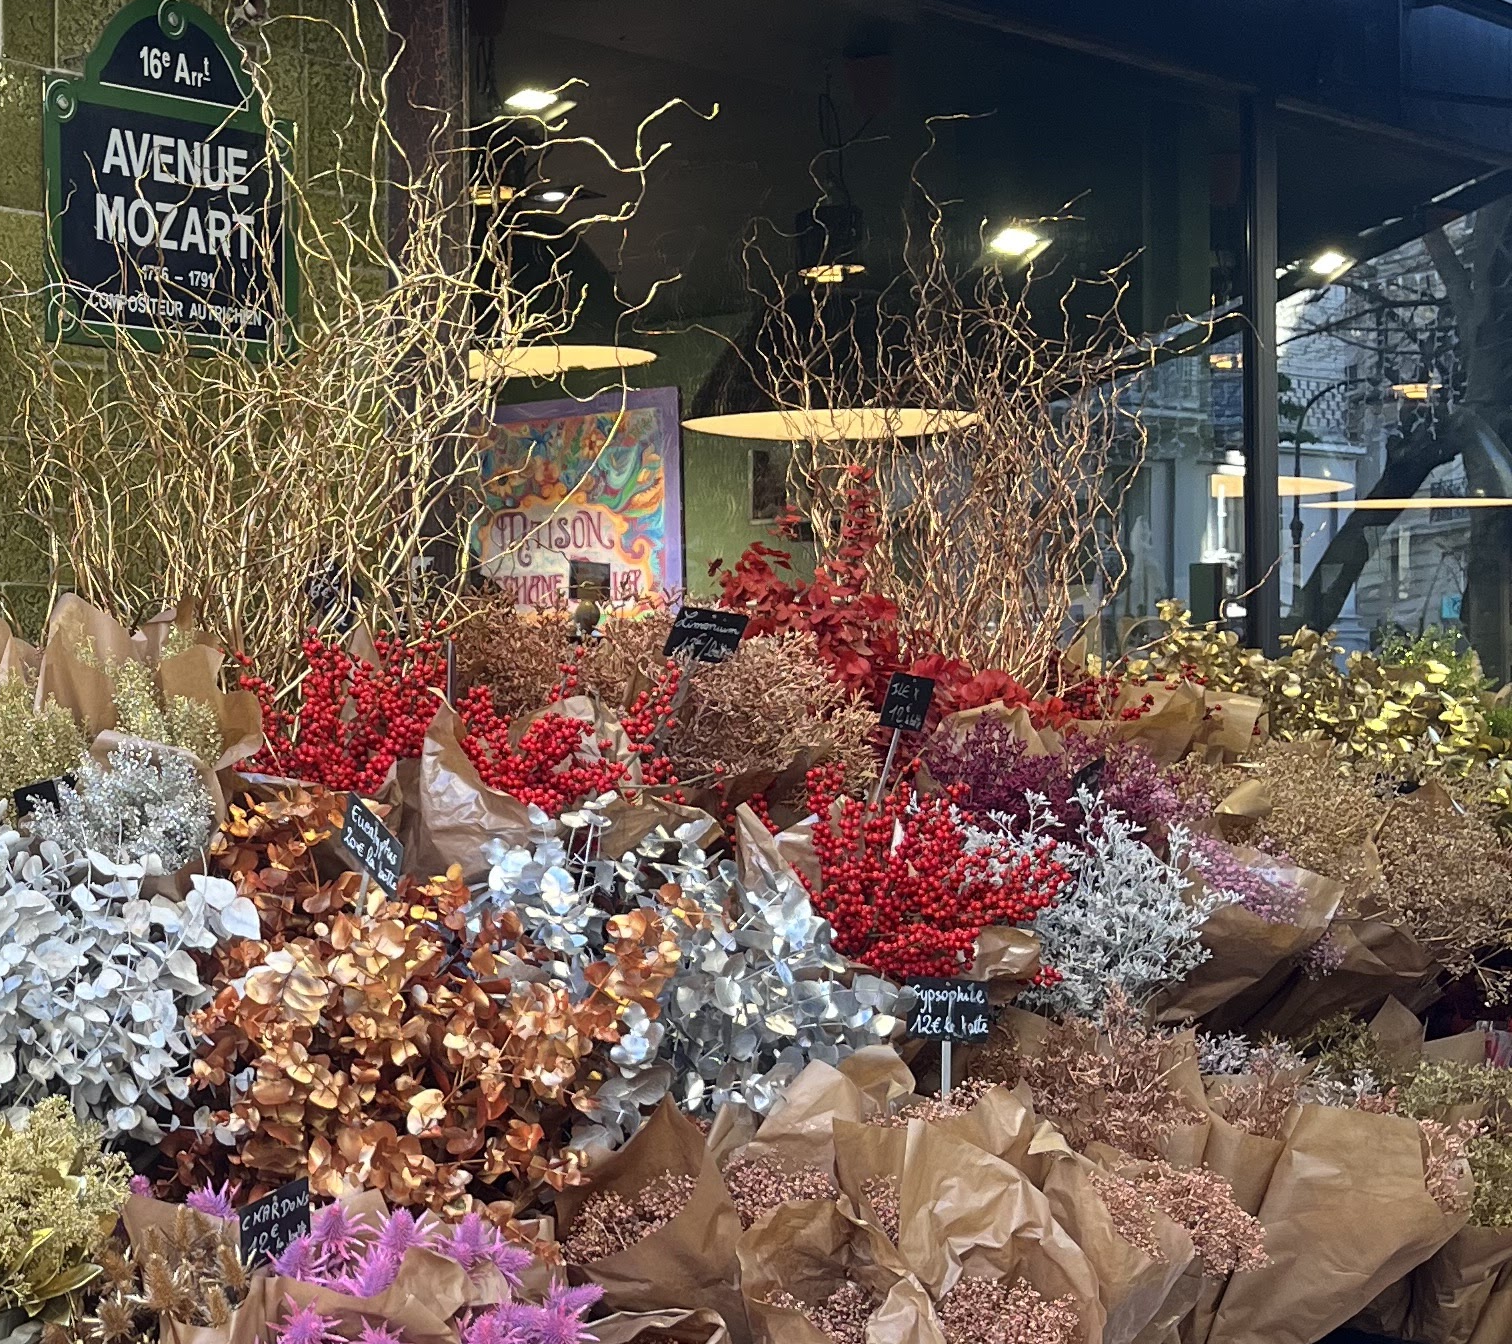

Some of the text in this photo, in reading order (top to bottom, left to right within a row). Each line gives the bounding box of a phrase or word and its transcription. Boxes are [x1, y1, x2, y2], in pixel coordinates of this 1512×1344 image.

[101, 127, 250, 196] AVENUE
[94, 193, 257, 261] MOZART
[142, 264, 170, 282] 176
[89, 290, 184, 319] COMPOSTEUR
